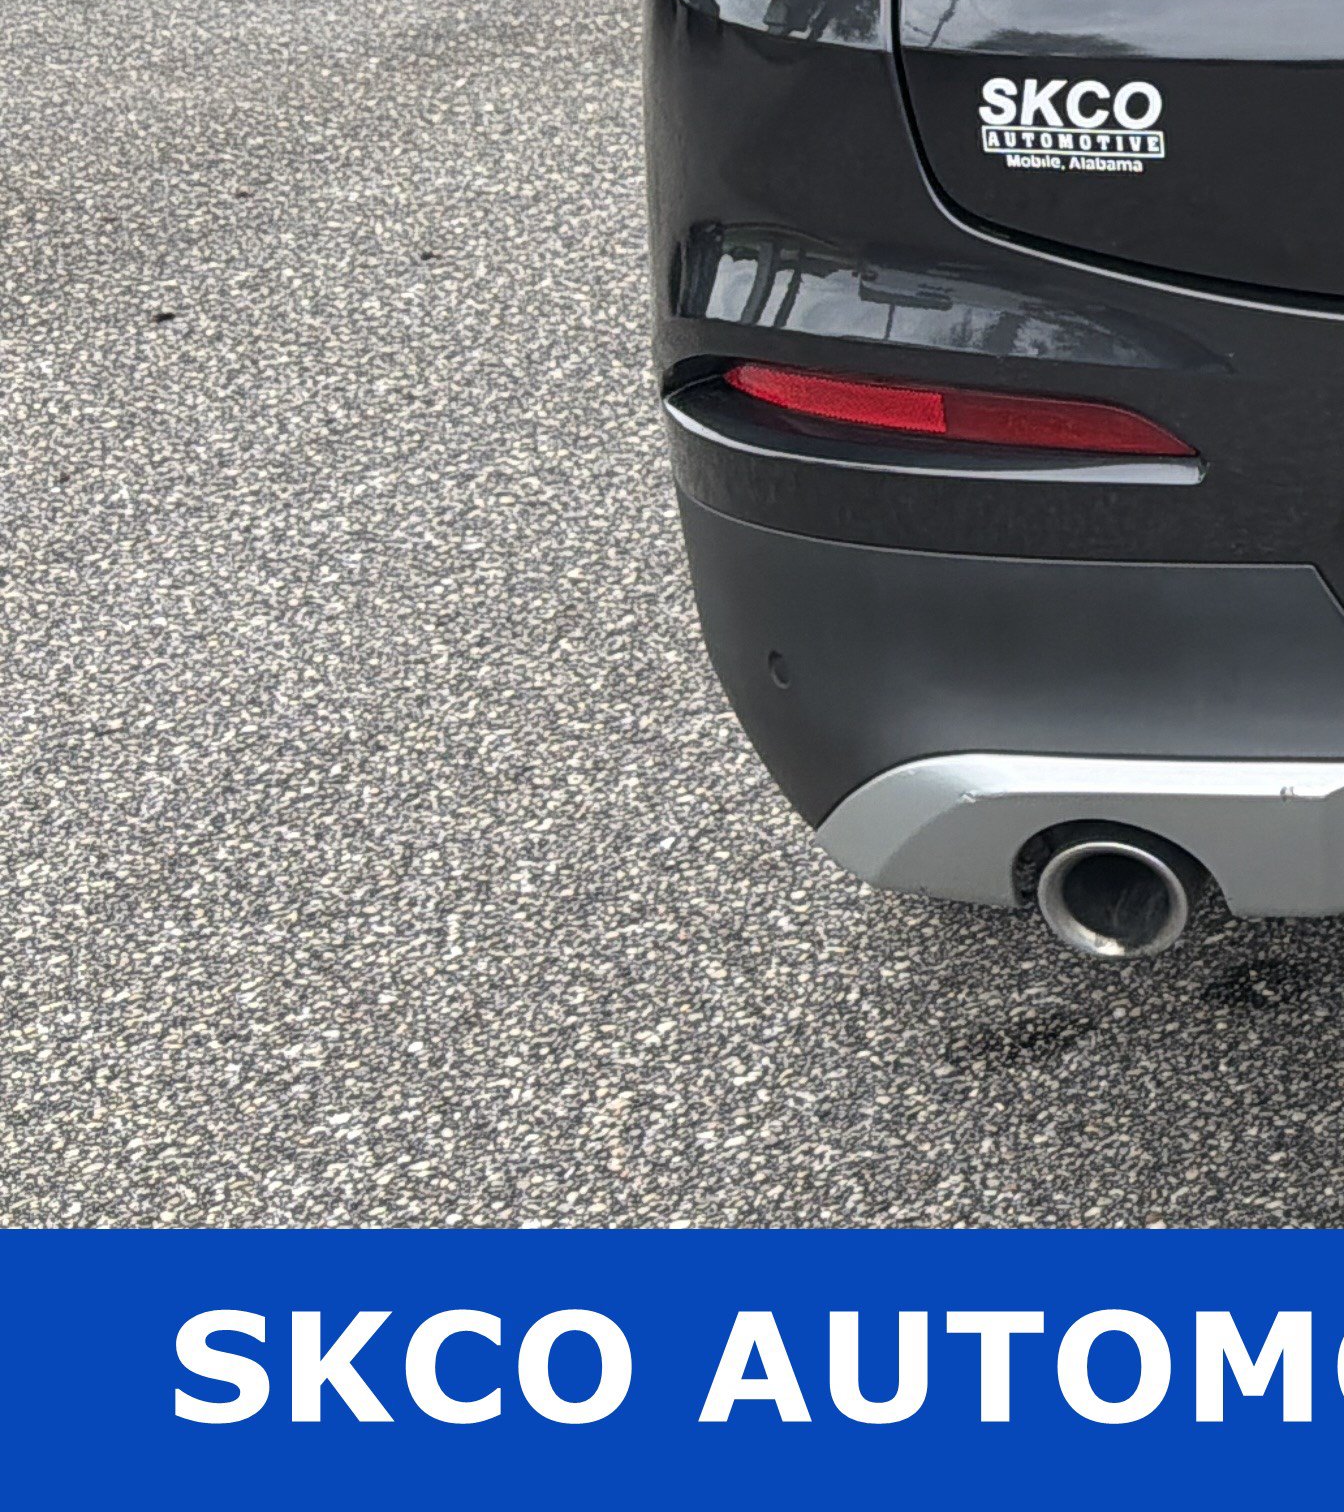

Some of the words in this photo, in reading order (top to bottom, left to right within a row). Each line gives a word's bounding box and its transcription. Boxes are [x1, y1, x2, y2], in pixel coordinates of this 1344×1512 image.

[978, 77, 1163, 130] SKCO
[987, 130, 1160, 152] AUTOMOTIVE
[1006, 154, 1066, 170] Mobile,
[1069, 156, 1144, 172] Alabama
